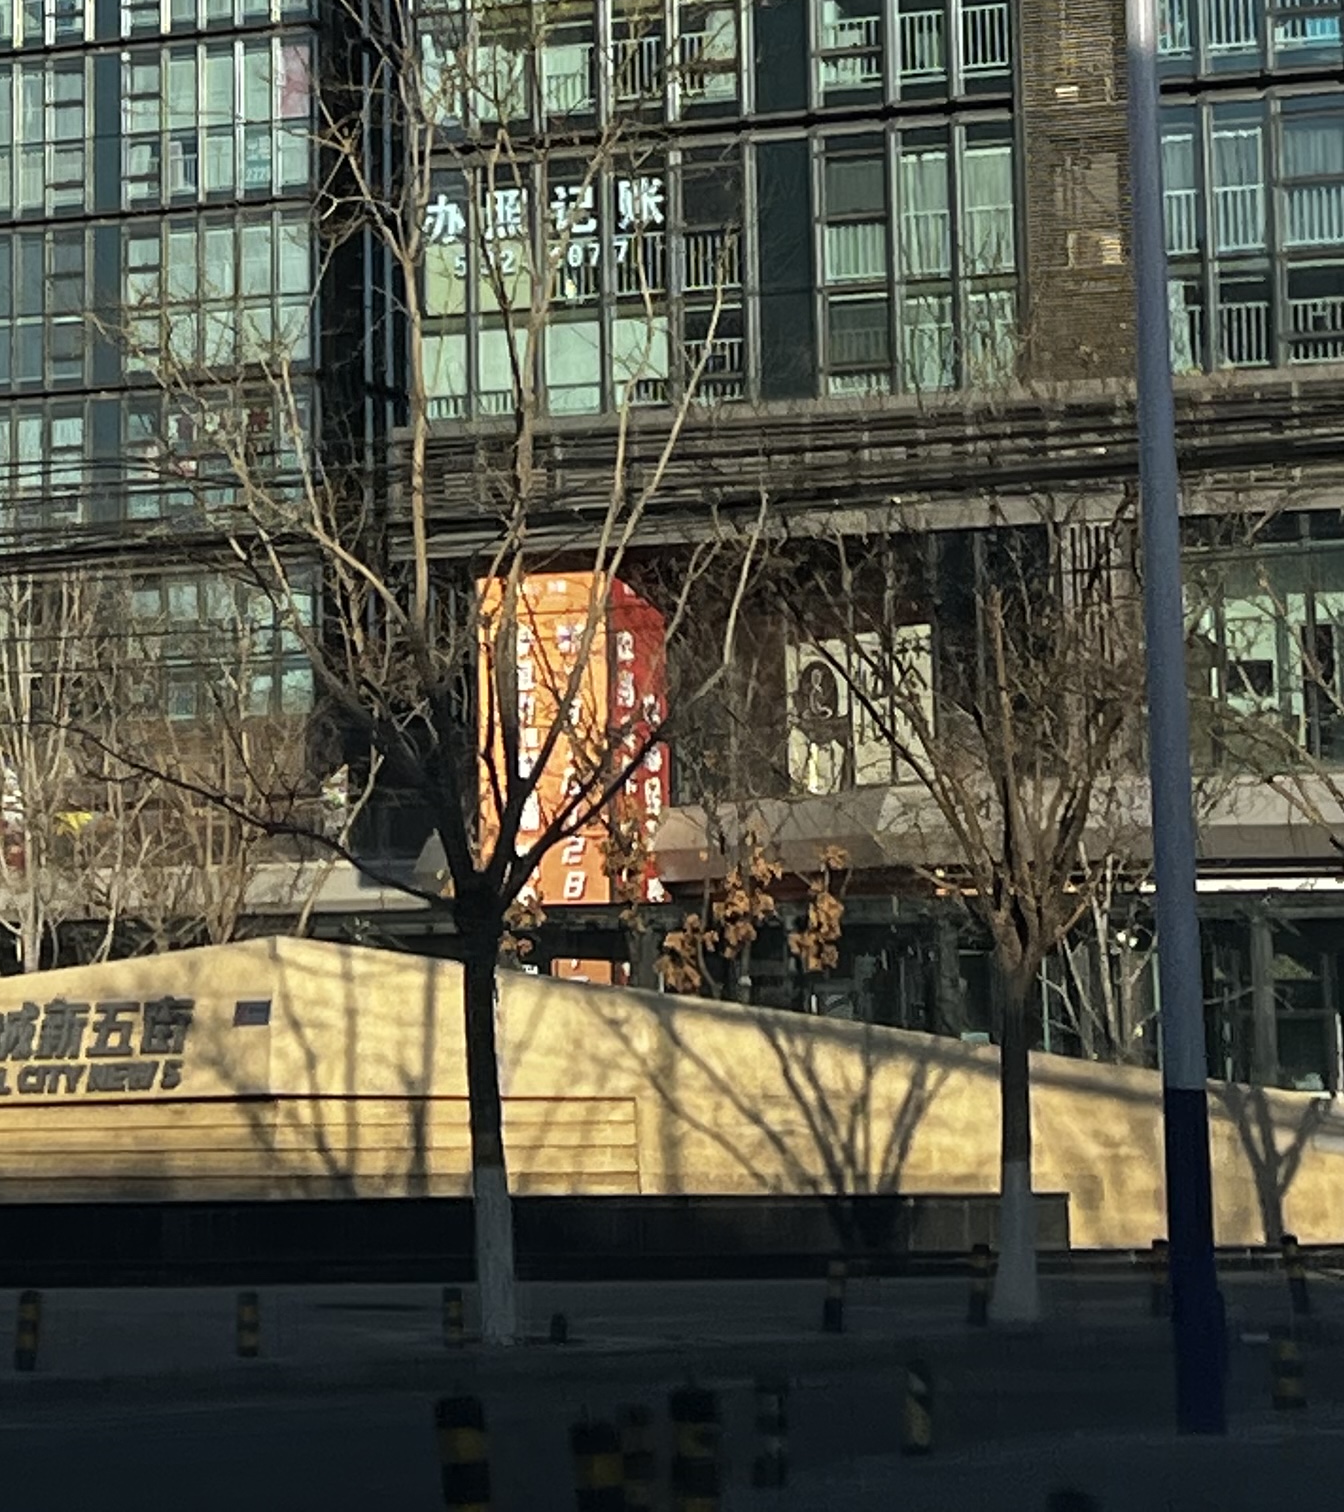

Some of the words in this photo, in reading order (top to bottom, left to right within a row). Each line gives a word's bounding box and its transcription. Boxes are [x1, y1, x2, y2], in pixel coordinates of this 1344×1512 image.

[422, 176, 665, 244] 办照记账
[17, 1065, 84, 1094] CITY
[86, 1062, 160, 1092] NEW
[162, 1059, 183, 1089] 5
